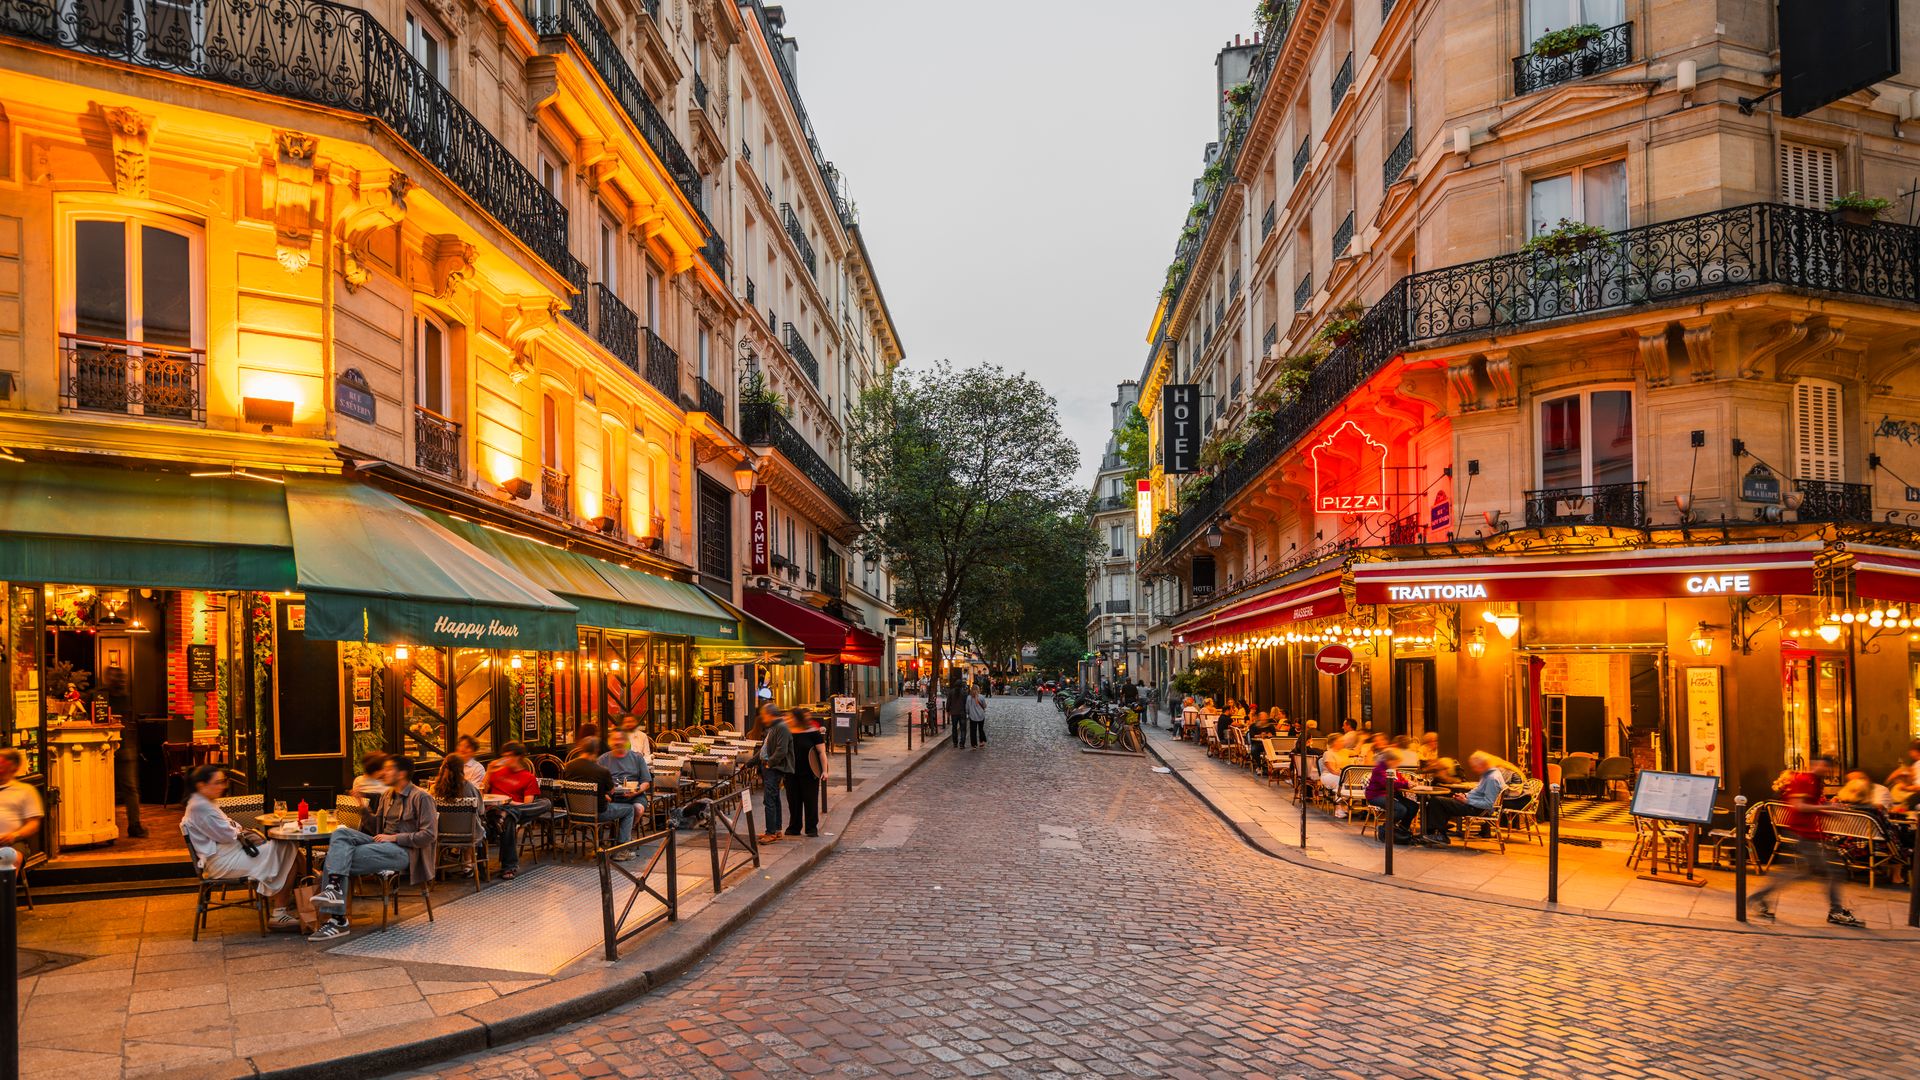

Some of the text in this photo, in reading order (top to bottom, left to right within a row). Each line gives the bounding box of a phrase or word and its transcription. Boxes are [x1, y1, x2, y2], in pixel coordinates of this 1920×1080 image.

[349, 391, 361, 403] RUE
[1174, 387, 1189, 471] HOTEL
[1322, 495, 1379, 509] PIZZA
[754, 511, 764, 565] RAMEN
[1193, 585, 1214, 593] HOTEL
[1388, 584, 1487, 600] TRATTORIA
[1686, 575, 1750, 593] CAFE
[433, 615, 520, 641] Happy Hour
